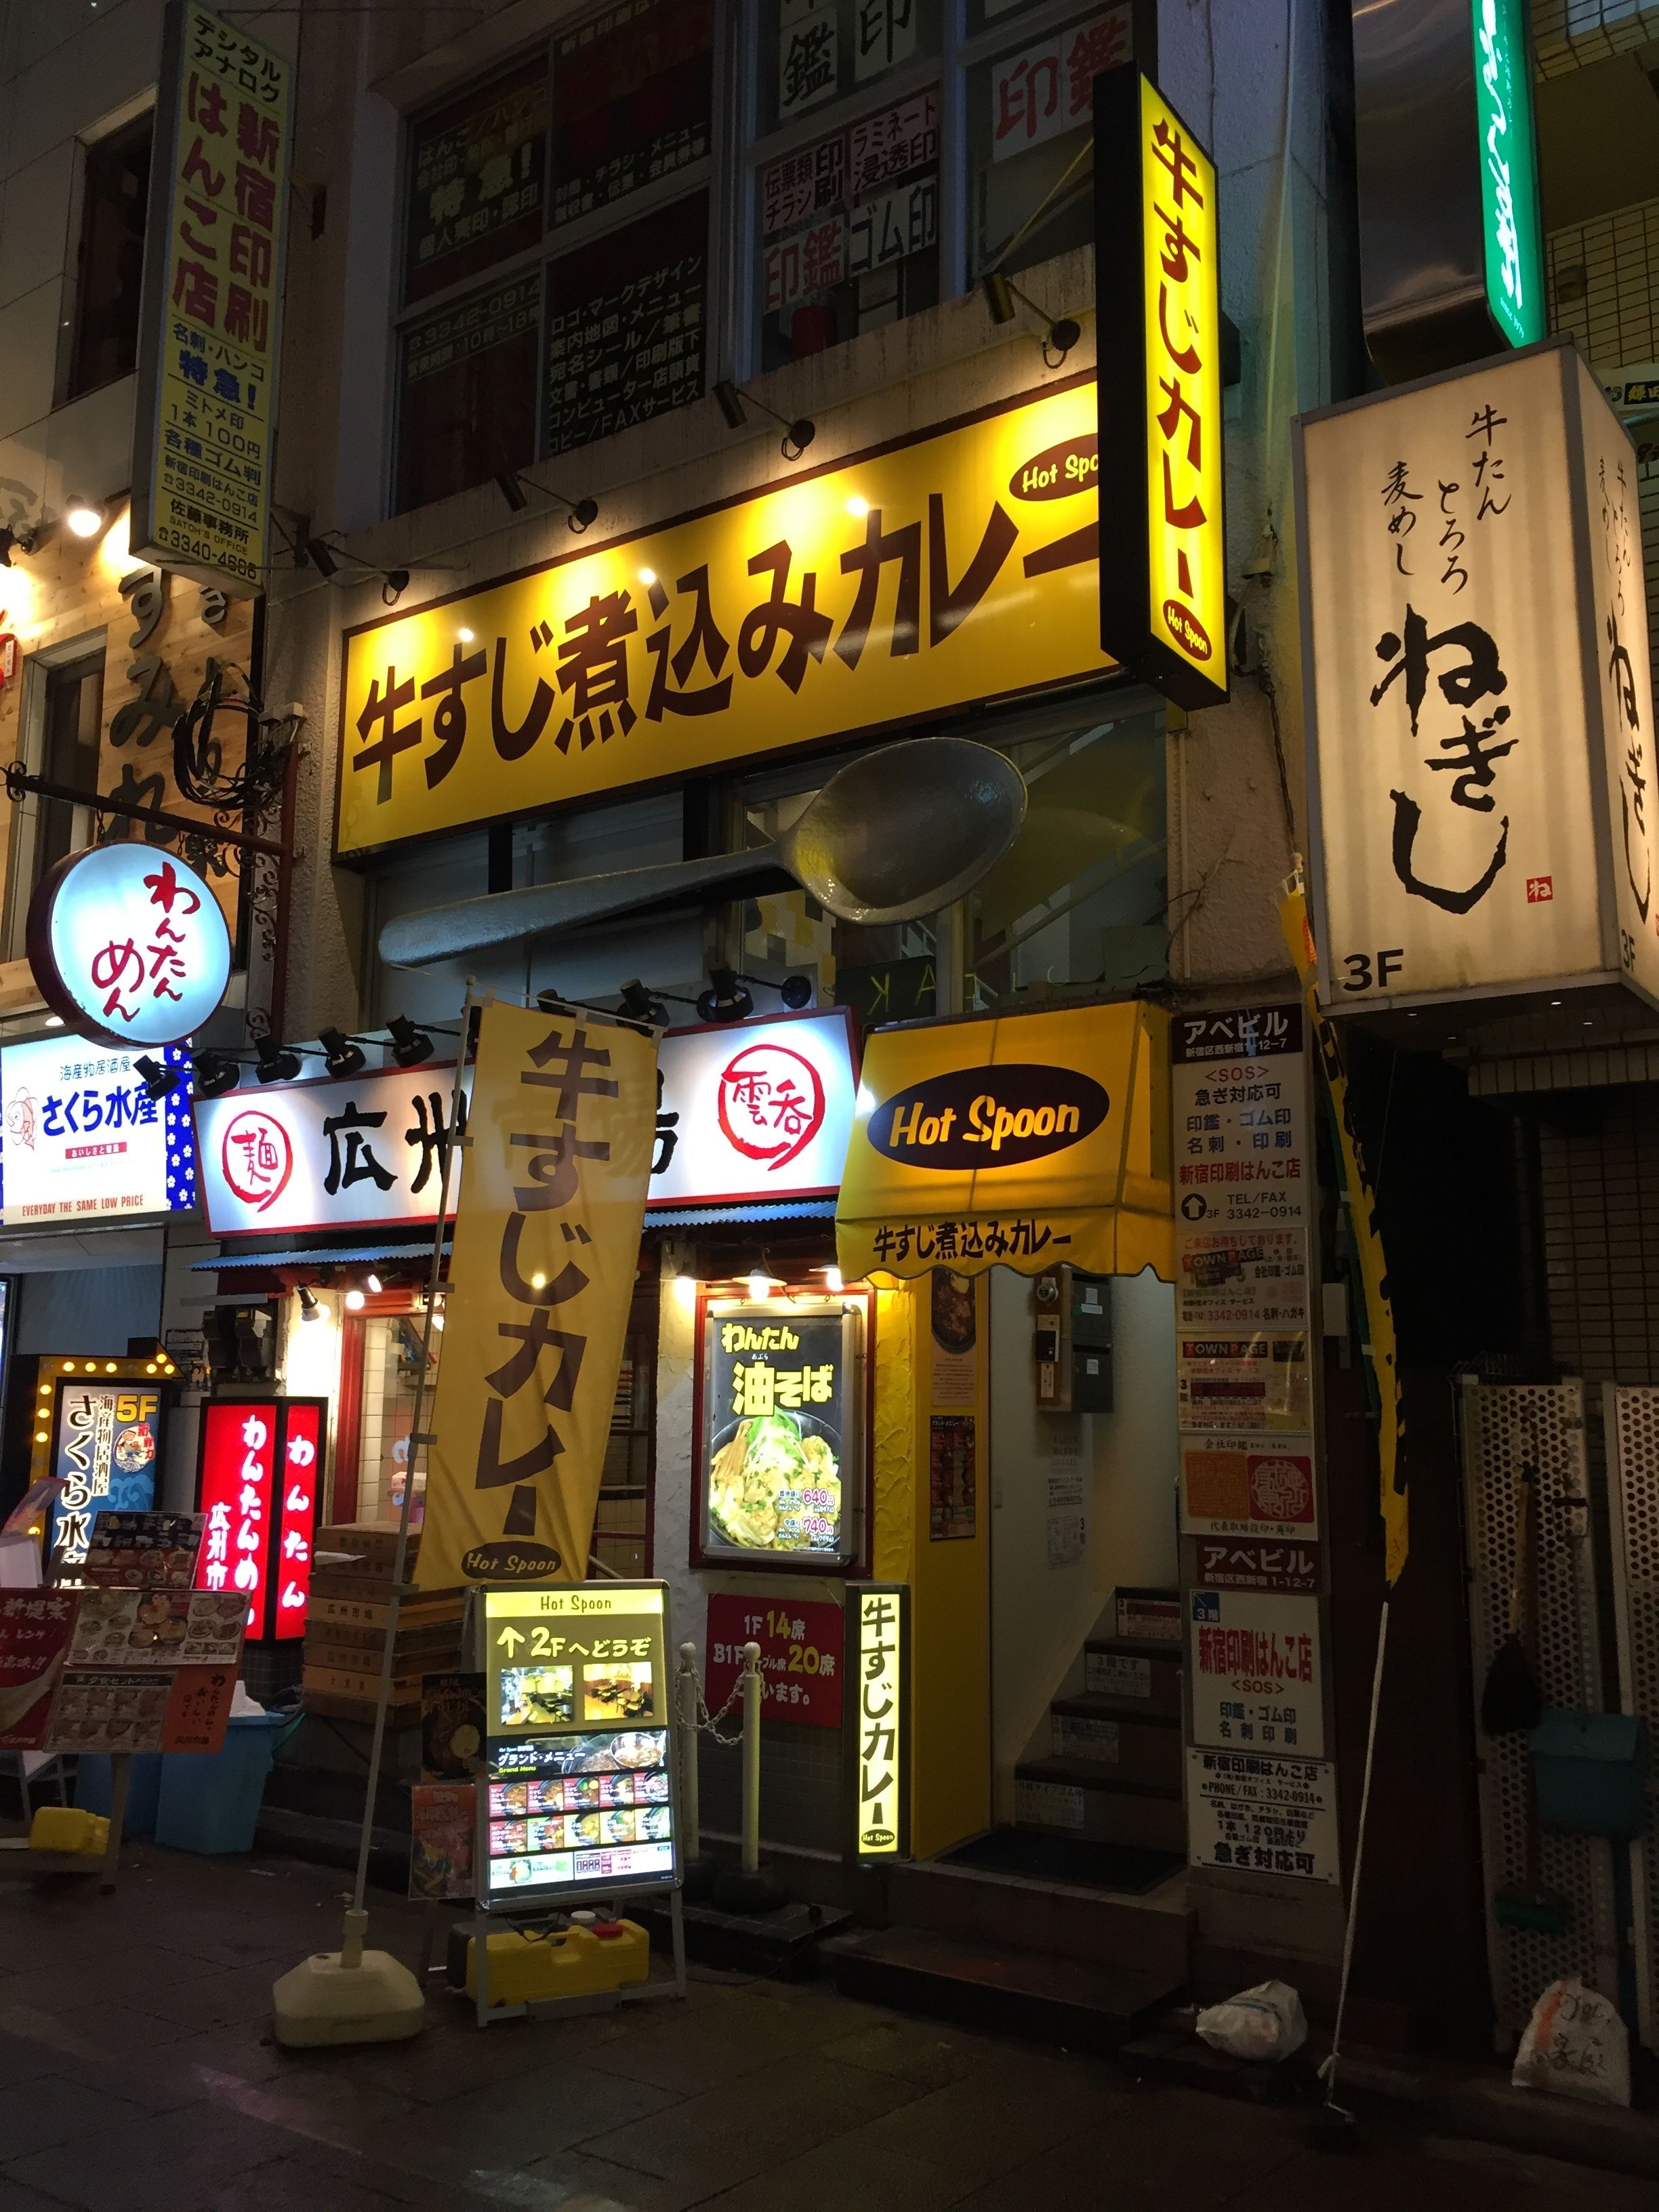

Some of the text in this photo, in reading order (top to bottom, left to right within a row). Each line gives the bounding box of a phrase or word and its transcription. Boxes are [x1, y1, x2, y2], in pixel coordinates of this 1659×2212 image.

[172, 70, 228, 329] はんこ店
[851, 178, 937, 272] ゴム印
[224, 102, 282, 353] 新宿印刷
[764, 221, 842, 310] 印鑑
[1151, 117, 1208, 597] 牛すじカレー
[1021, 466, 1059, 493] Hot
[1465, 405, 1512, 520] 牛たん
[176, 476, 258, 525] 3342-0914
[1380, 461, 1424, 576] 麦めし
[1437, 480, 1469, 596] とろろ
[352, 493, 1099, 806] 牛すじ煮込みカレー
[1166, 605, 1208, 656] Hot Spoon
[1370, 602, 1519, 915] ねぎし
[144, 861, 201, 1002] わんたん
[91, 937, 145, 1023] めん
[1343, 949, 1404, 991] 3F
[1184, 1010, 1288, 1044] アベビル
[60, 1056, 131, 1081] 海産物居酒屋
[42, 1081, 159, 1137] さくら水産
[1194, 1083, 1282, 1107] 急ぎ対応可
[889, 1095, 1080, 1151] Hot Spoon
[1179, 1158, 1300, 1185] 新宿印刷はんこ店
[22, 1195, 144, 1216] EVERYDAY THE SAME LOW PRICE
[1206, 1206, 1302, 1220] 3F 3342-0914
[873, 1219, 1071, 1262] 牛すじ煮込みカレー
[475, 1029, 619, 1537] 牛すじカレー
[721, 1322, 800, 1353] わんたん
[115, 1393, 158, 1422] 5F
[732, 1361, 834, 1416] 油そば
[56, 1395, 96, 1564] さくら水
[234, 1414, 267, 1626] わんたんめ
[281, 1434, 315, 1608] わんたん
[466, 1553, 556, 1573] Hot Spoon
[1204, 1546, 1315, 1575] アベビル
[541, 1595, 612, 1613] Hot Spoon
[744, 1610, 806, 1641] 1F 14席
[531, 1626, 652, 1659] 2Fへどうぞ
[713, 1643, 744, 1664] B1F
[788, 1644, 836, 1677] 20席
[1199, 1624, 1312, 1683] 新宿印刷はんこ店
[861, 1597, 895, 1824] 牛すじカレー
[498, 1750, 586, 1766] グランド・メニュー
[1203, 1754, 1318, 1782] 新宿印刷はんこ店
[1214, 1841, 1316, 1875] 急ぎ対応可
